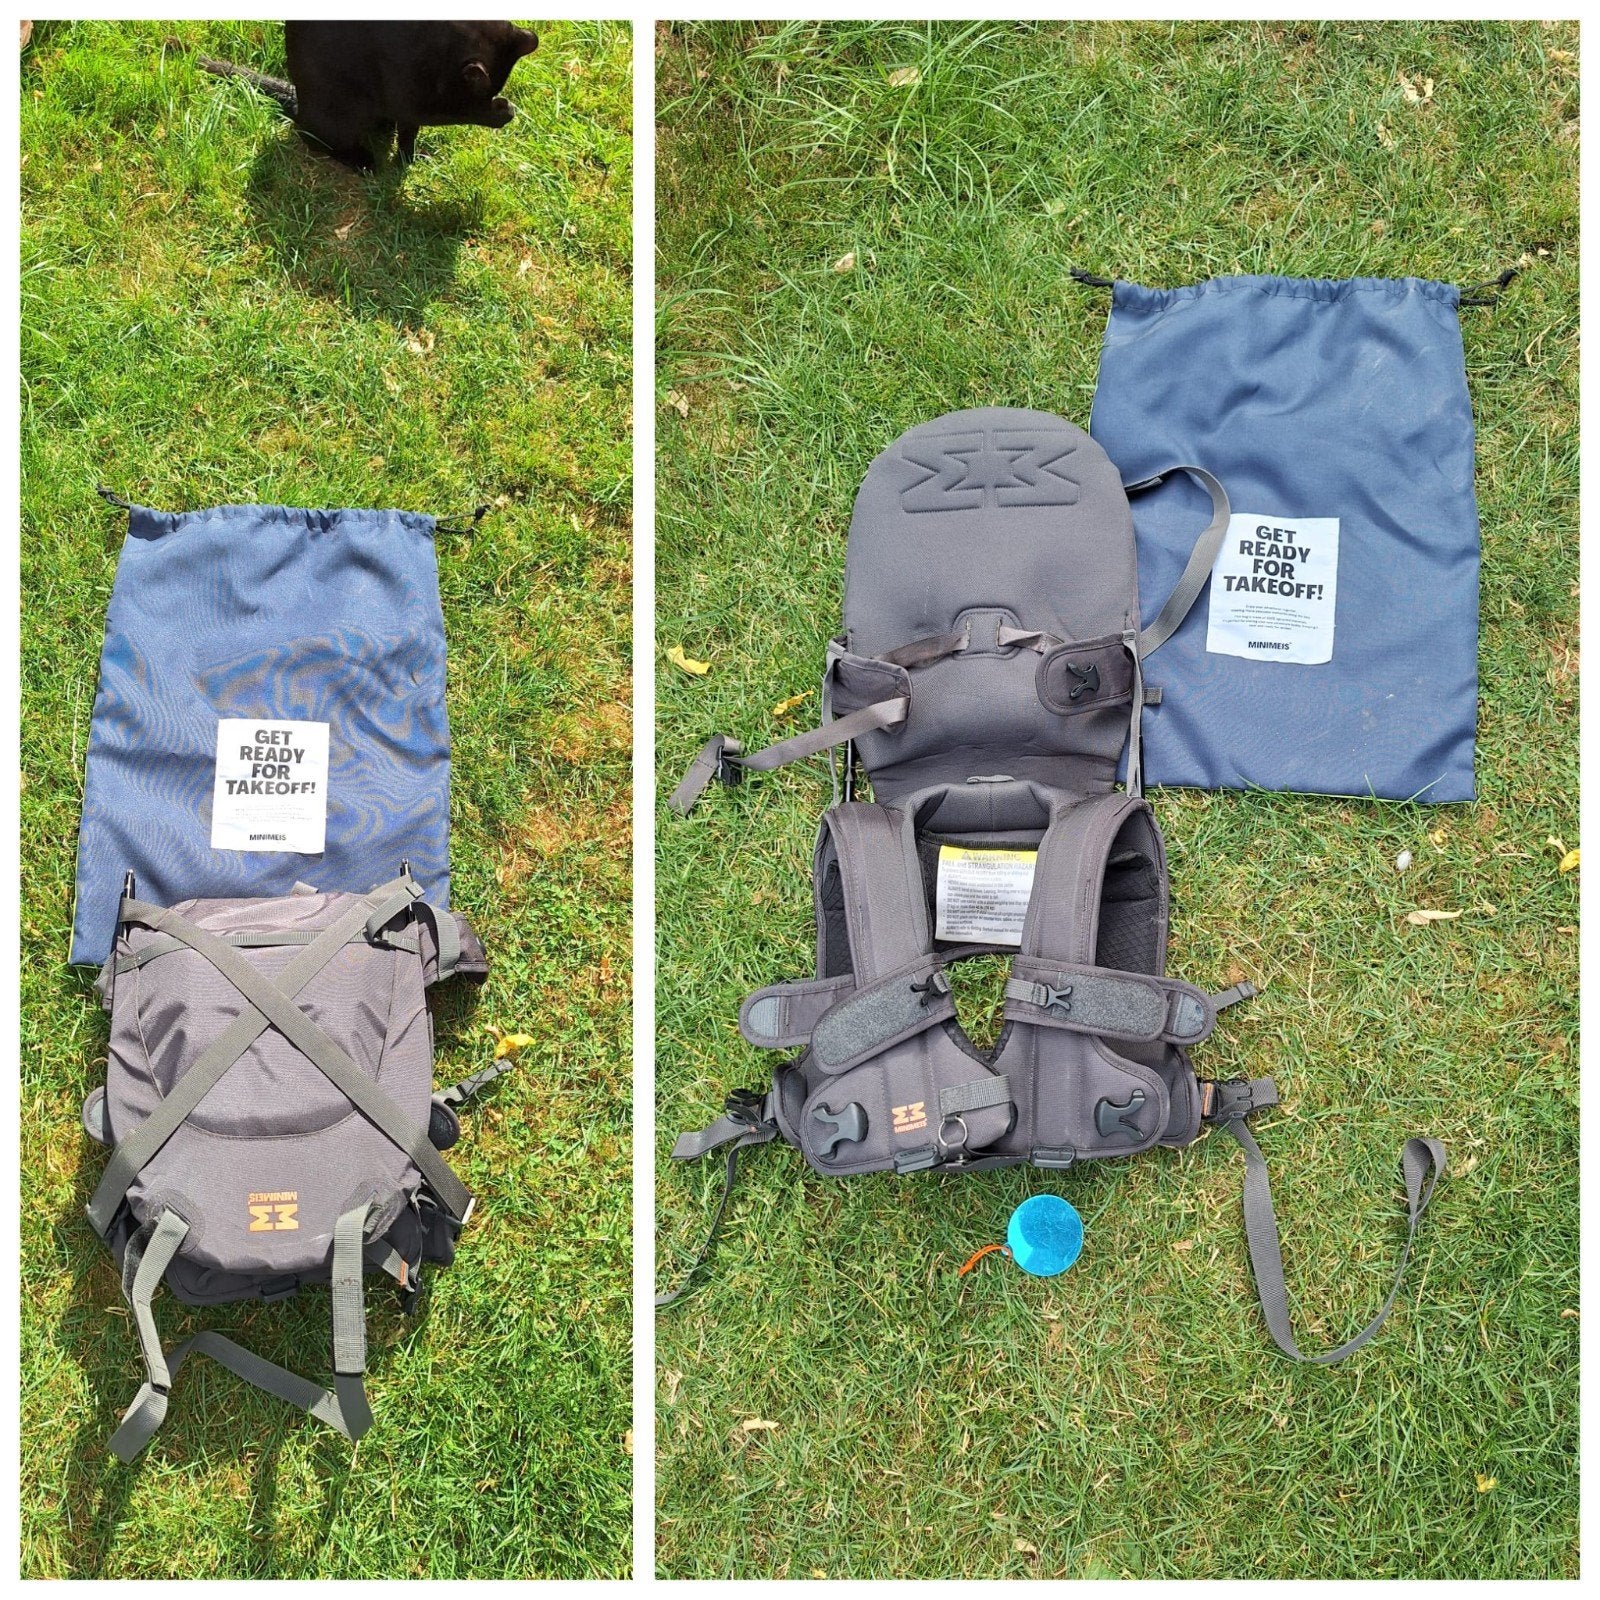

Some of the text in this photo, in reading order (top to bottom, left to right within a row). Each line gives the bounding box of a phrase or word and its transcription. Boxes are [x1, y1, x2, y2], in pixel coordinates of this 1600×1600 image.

[1256, 525, 1297, 544] GET
[1239, 540, 1311, 563] READY
[1253, 558, 1295, 580] FOR
[1223, 575, 1324, 600] TAKEOFF!
[1248, 641, 1290, 650] MINIMEIS
[255, 729, 293, 745] GET
[240, 745, 305, 763] READY
[251, 763, 291, 780] FOR
[225, 779, 316, 795] TAKEOFF!
[249, 1191, 298, 1203] MINIMEIS
